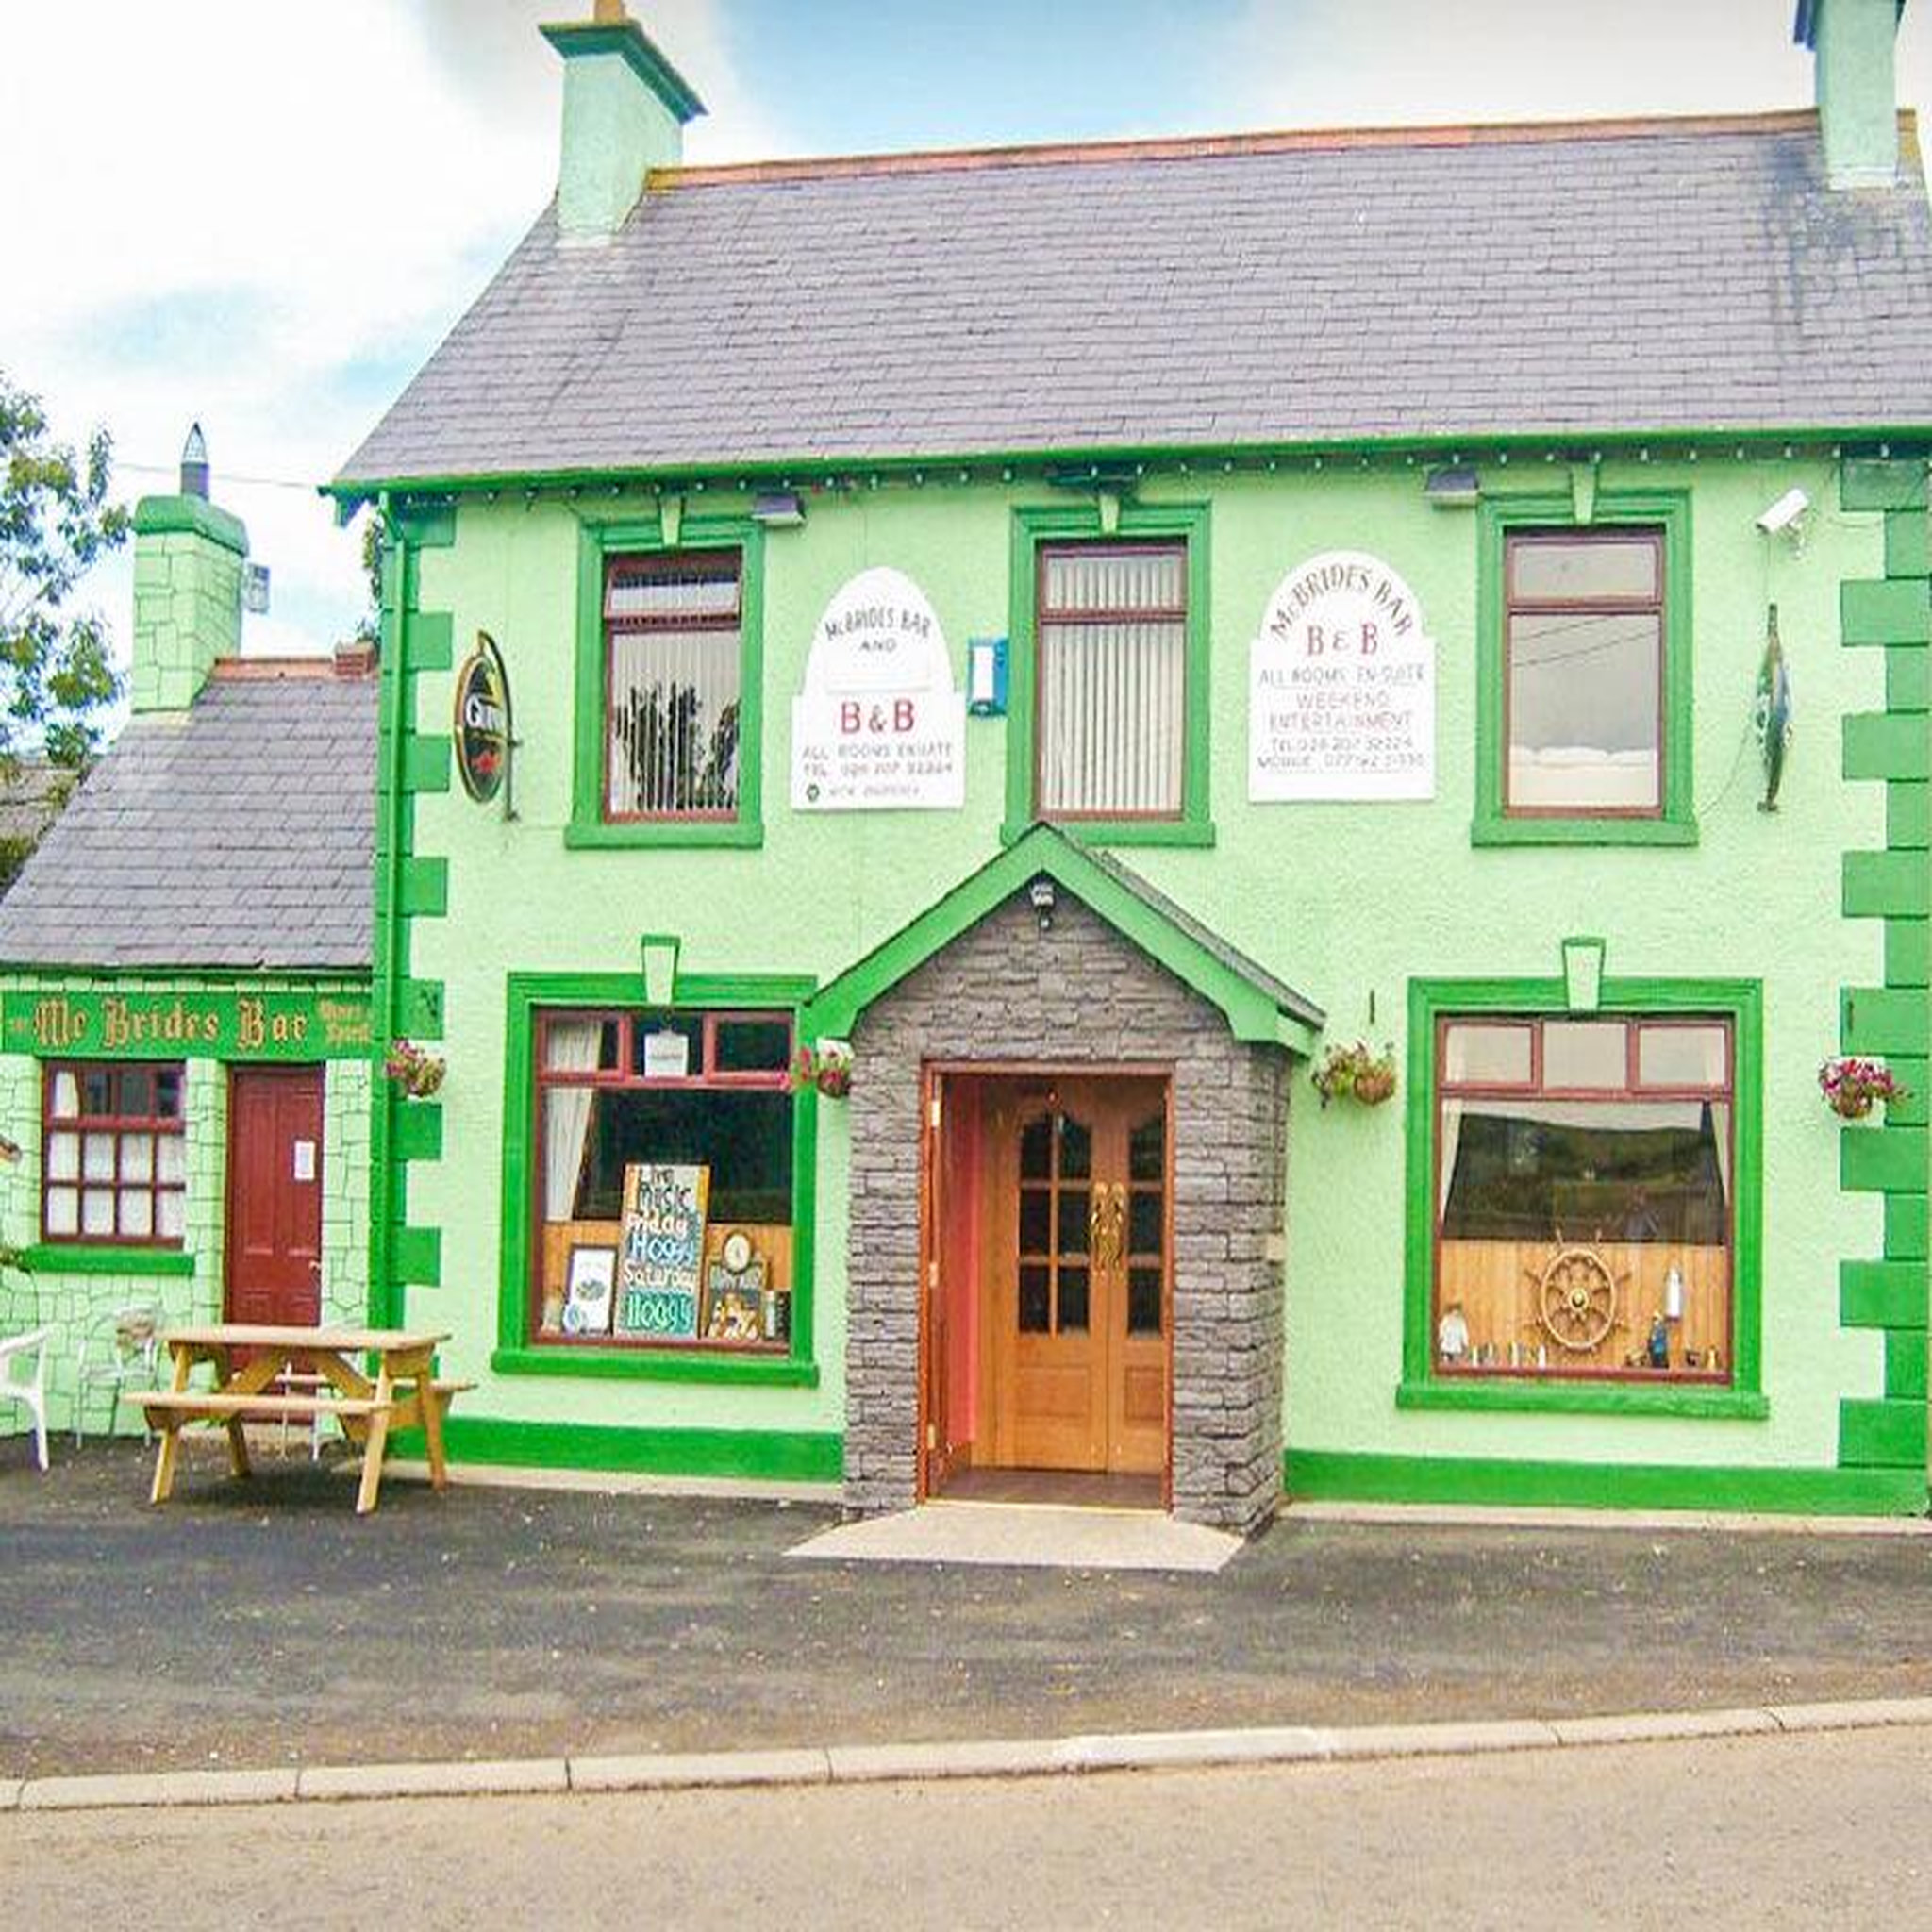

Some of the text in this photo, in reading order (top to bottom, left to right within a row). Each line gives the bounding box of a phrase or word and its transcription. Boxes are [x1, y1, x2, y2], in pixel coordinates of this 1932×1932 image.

[901, 609, 931, 638] BAR
[1374, 579, 1414, 637] BAR
[859, 637, 897, 653] AND
[1307, 625, 1324, 656] B
[1360, 623, 1378, 655] B
[841, 698, 915, 734] B & B
[1296, 690, 1391, 709] WEEKEND
[101, 996, 219, 1049] Brides
[238, 997, 307, 1049] Bar
